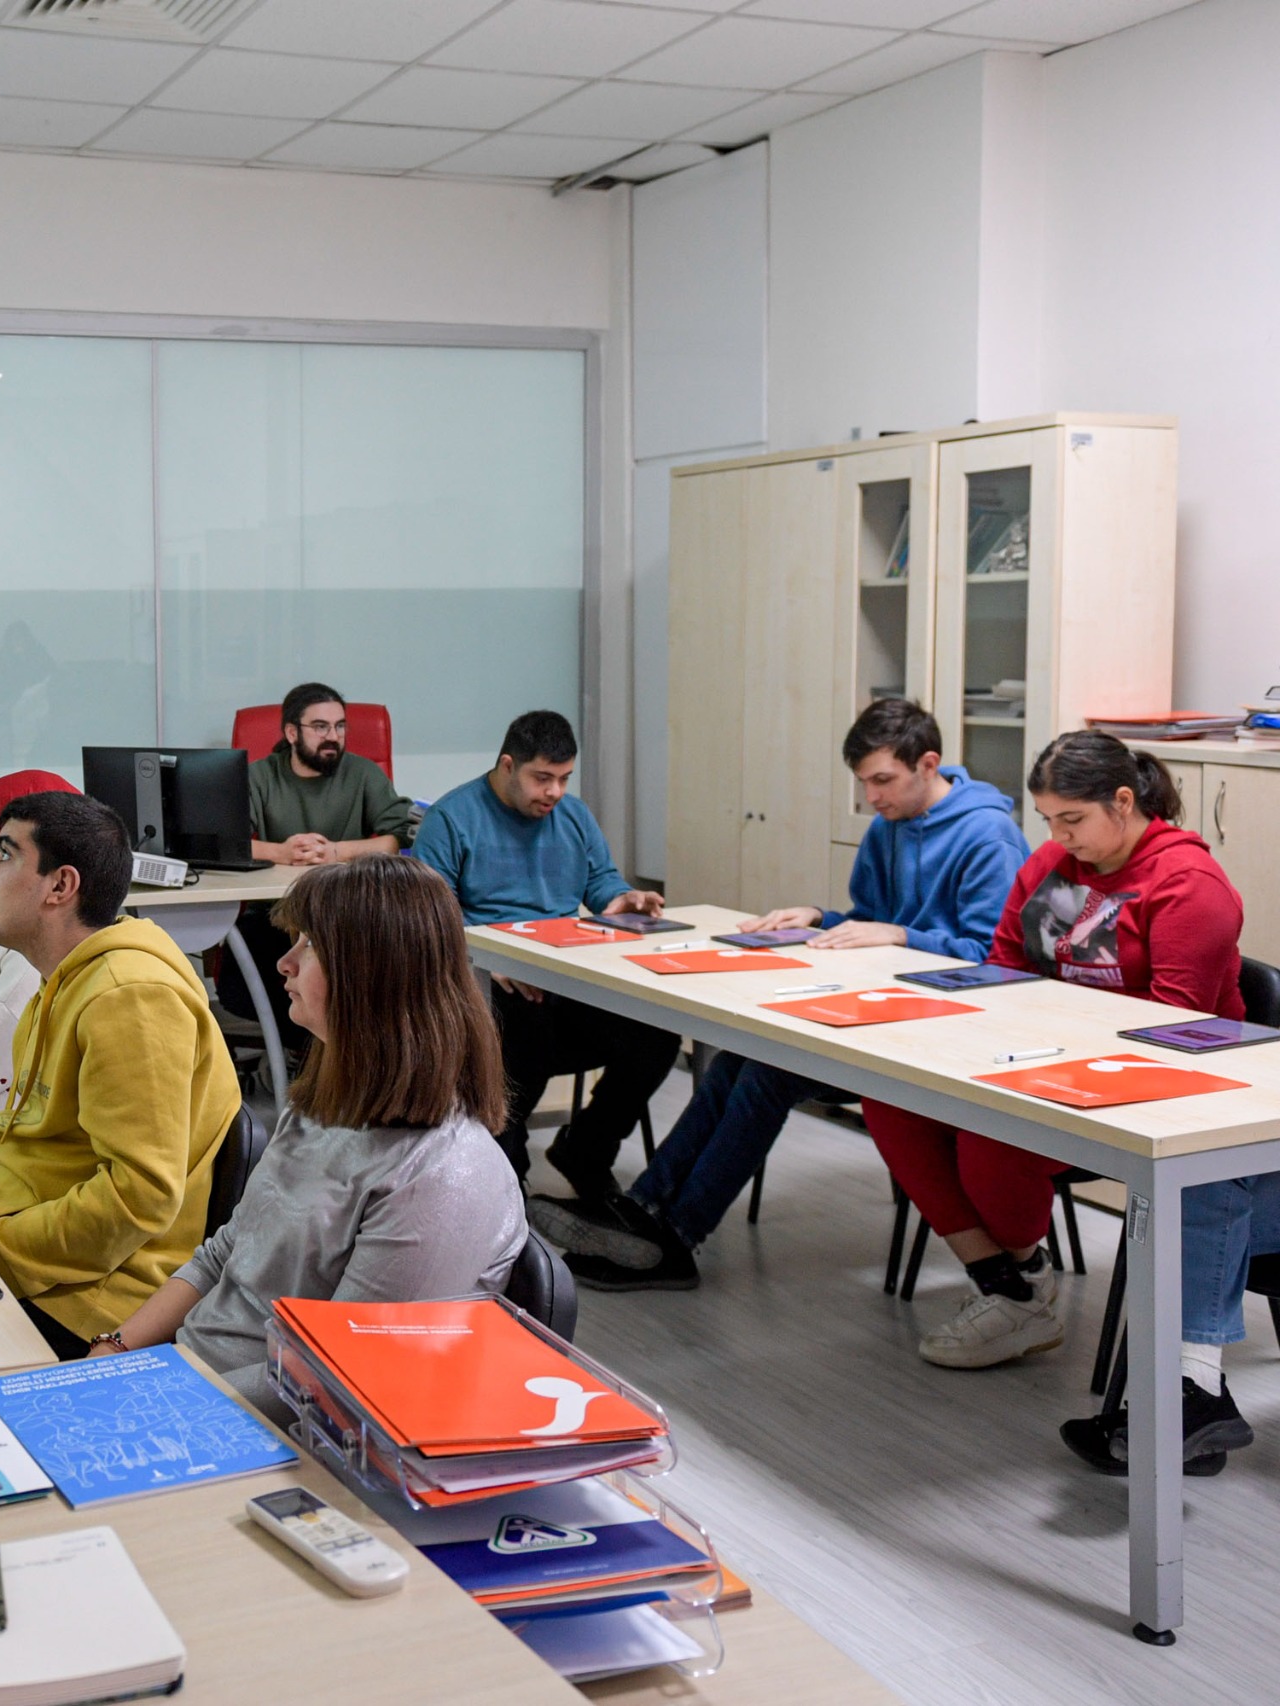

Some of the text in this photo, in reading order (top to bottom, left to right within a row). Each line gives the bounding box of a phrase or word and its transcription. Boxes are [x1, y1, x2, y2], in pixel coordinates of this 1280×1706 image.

[32, 1363, 95, 1380] BÜYÜKŞEHİR
[96, 1352, 151, 1367] BELEDİYESİ
[1, 1386, 31, 1396] İZMİR
